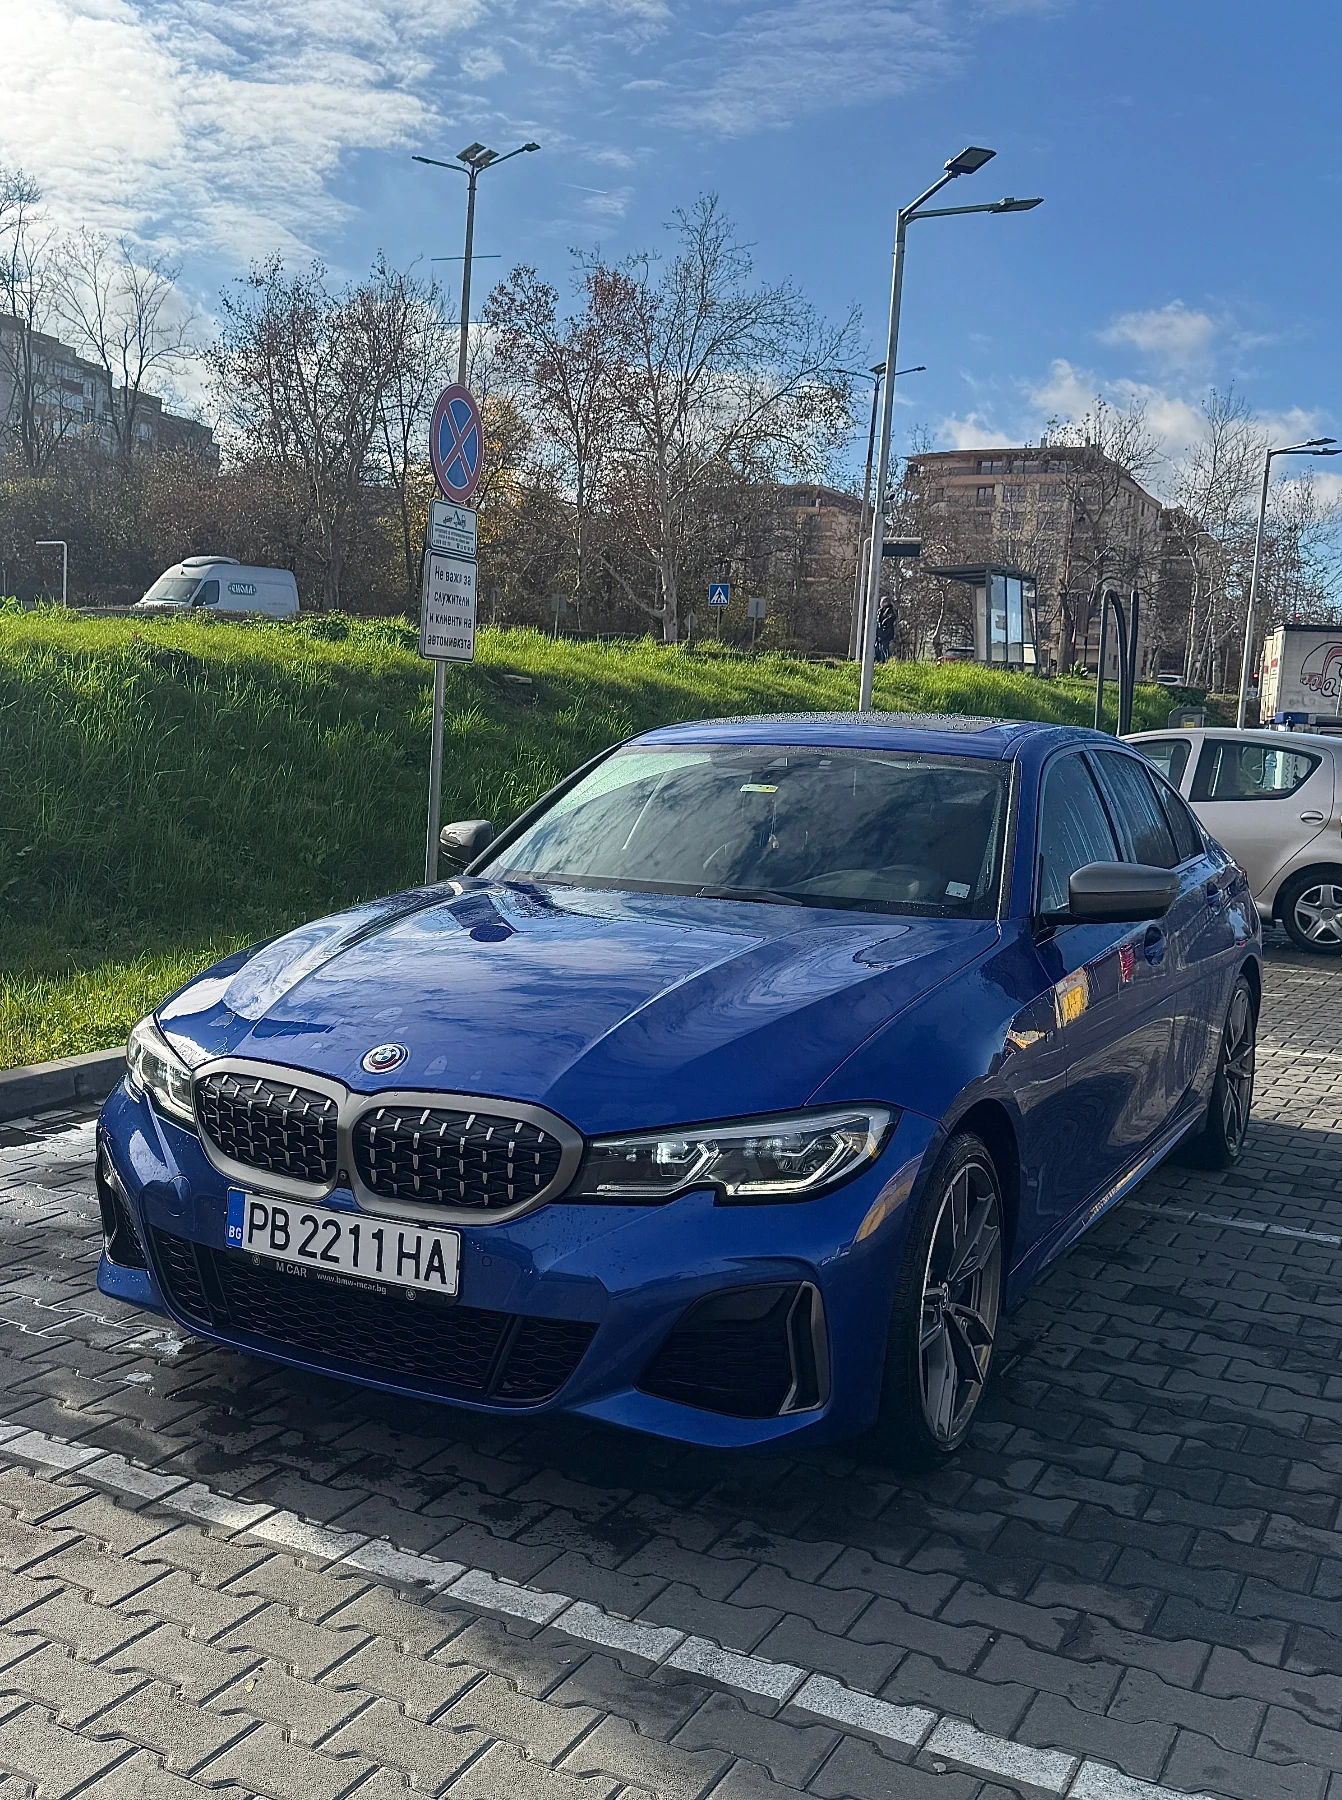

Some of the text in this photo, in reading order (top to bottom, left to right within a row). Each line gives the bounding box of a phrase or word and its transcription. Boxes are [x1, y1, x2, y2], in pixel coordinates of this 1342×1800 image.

[434, 565, 472, 586] Не важи за
[434, 591, 470, 607] служители
[429, 612, 472, 629] и клиенти на
[228, 1225, 242, 1240] BG
[286, 1264, 307, 1278] CAR
[316, 1272, 387, 1295] www.bmw-mcar.bg
